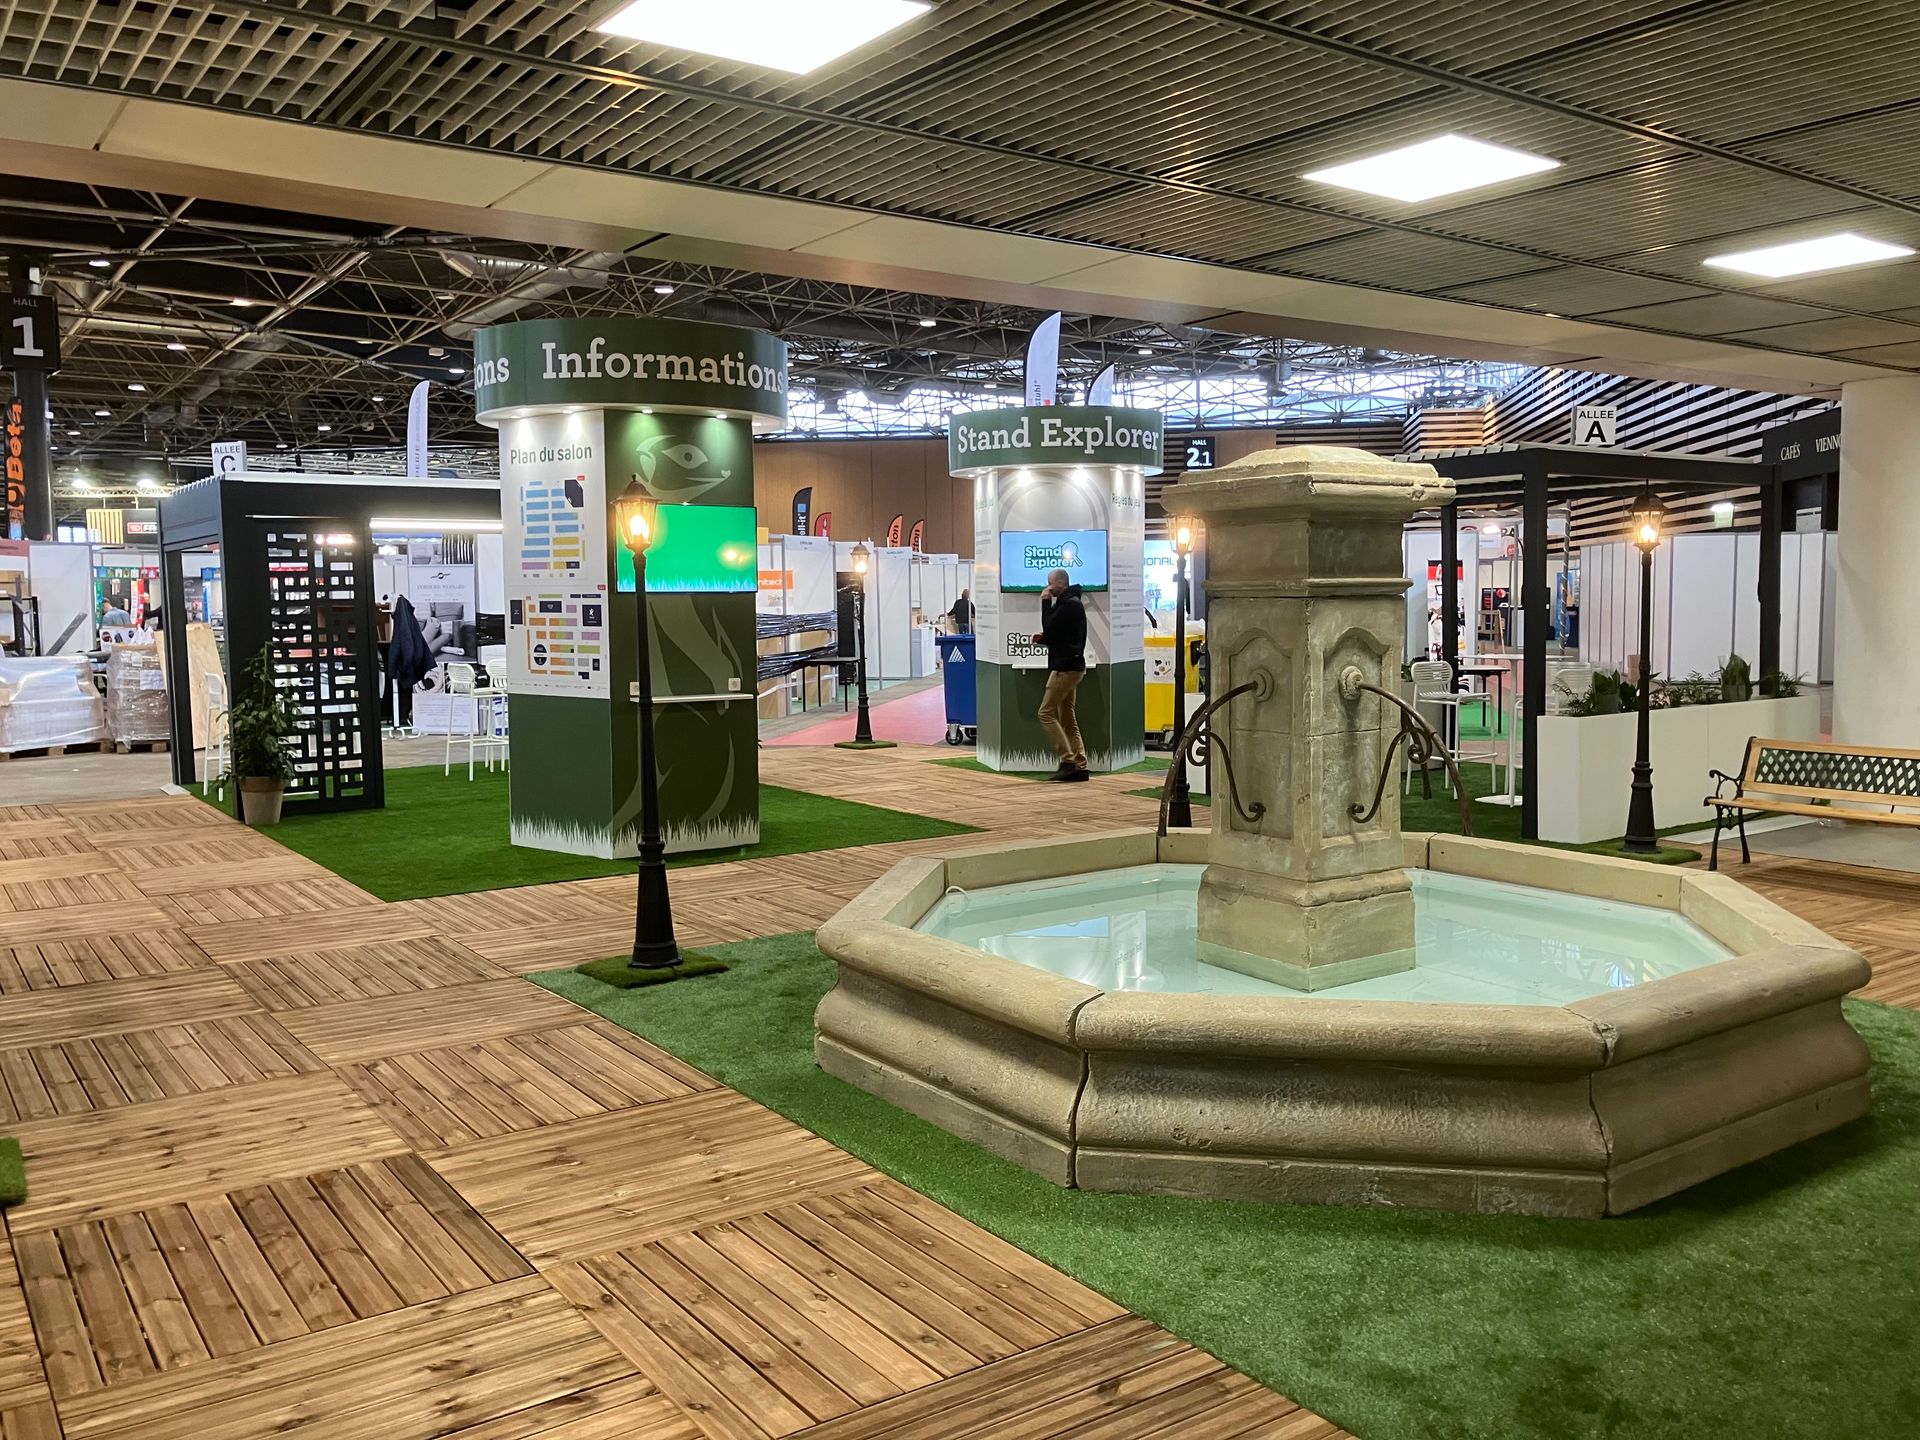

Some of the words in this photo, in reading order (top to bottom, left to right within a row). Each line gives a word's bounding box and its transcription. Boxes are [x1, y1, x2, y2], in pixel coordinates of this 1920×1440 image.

[13, 297, 39, 307] HALL
[13, 317, 44, 357] 1
[542, 337, 784, 394] Informations
[1579, 410, 1614, 419] ALLEE
[958, 417, 1032, 453] Stand
[1041, 416, 1159, 454] Explorer
[1584, 420, 1607, 442] A
[214, 446, 241, 454] ALLEE
[510, 449, 536, 465] Plan
[539, 446, 555, 463] du
[557, 443, 592, 461] salon
[1186, 447, 1212, 467] 2.1
[1780, 442, 1801, 461] CAFÉS
[221, 455, 236, 472] C
[1025, 546, 1062, 557] Stand
[1025, 557, 1074, 570] Explorer
[1007, 633, 1033, 645] Sta
